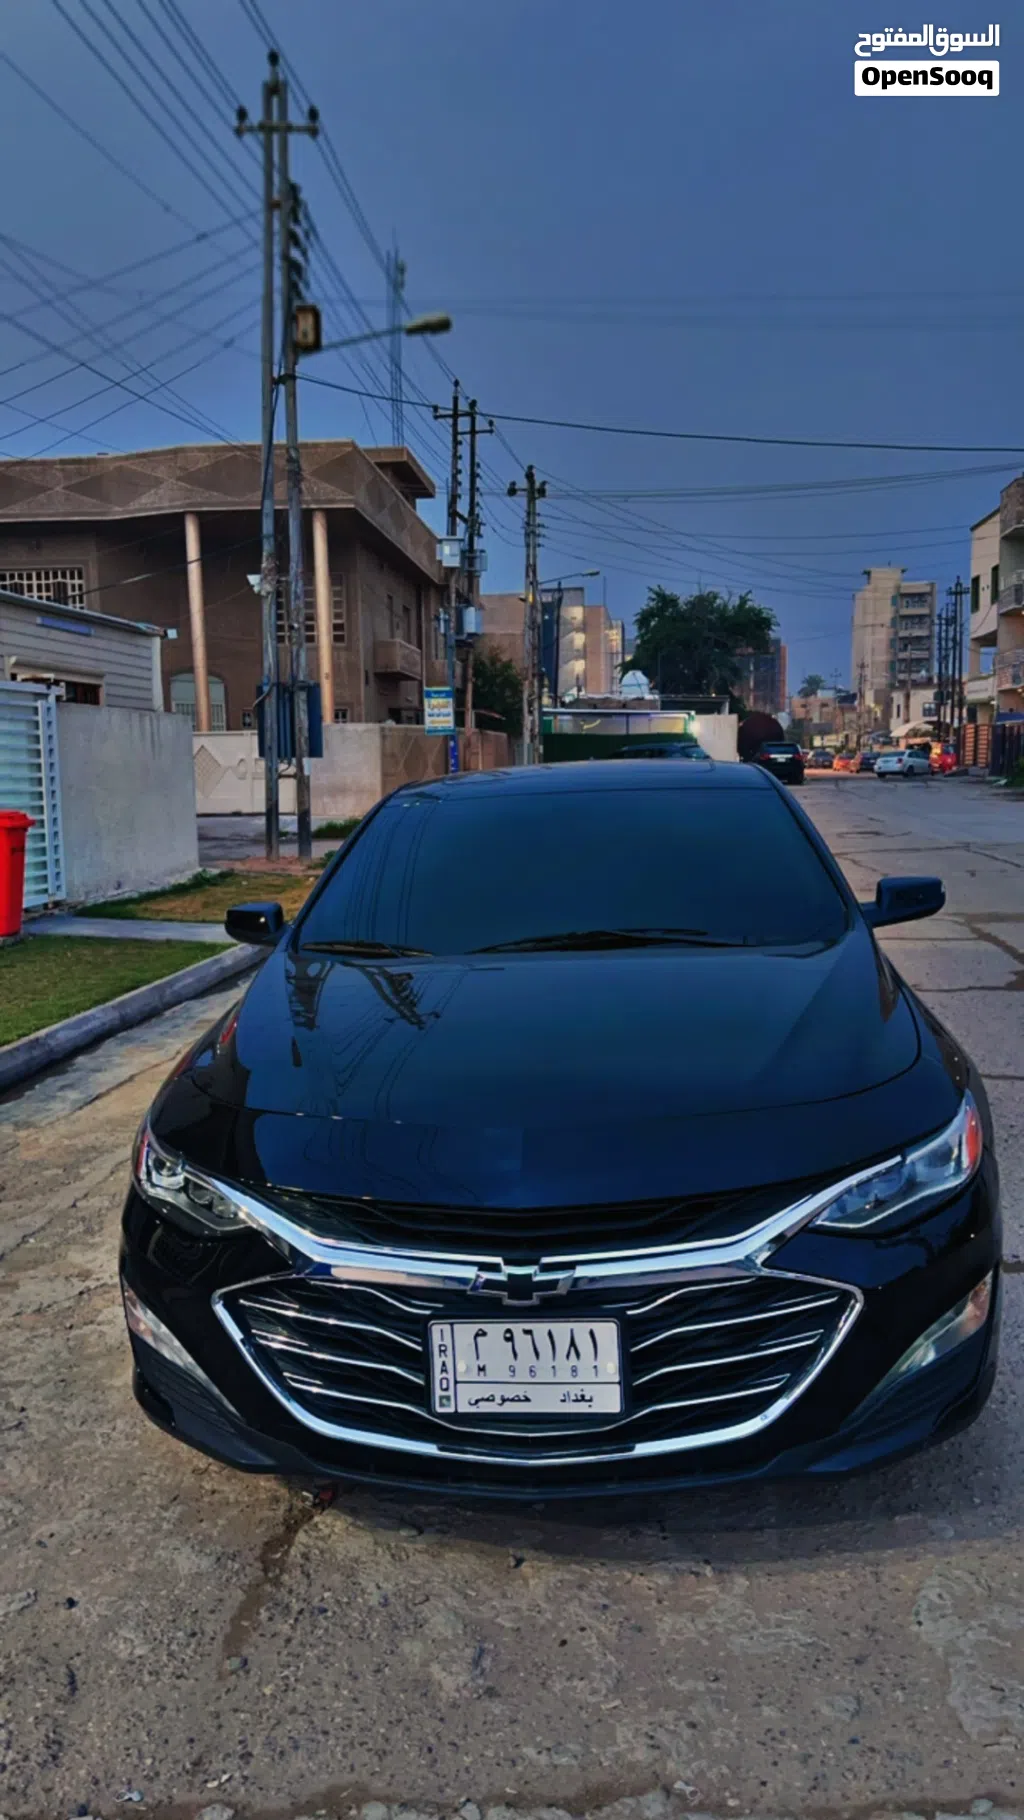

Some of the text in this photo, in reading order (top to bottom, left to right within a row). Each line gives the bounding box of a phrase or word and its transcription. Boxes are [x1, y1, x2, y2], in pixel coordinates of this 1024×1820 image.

[438, 1328, 450, 1392] IRAQ
[508, 1365, 599, 1378] 96181
[467, 1388, 594, 1409] بغداد خصوصي
